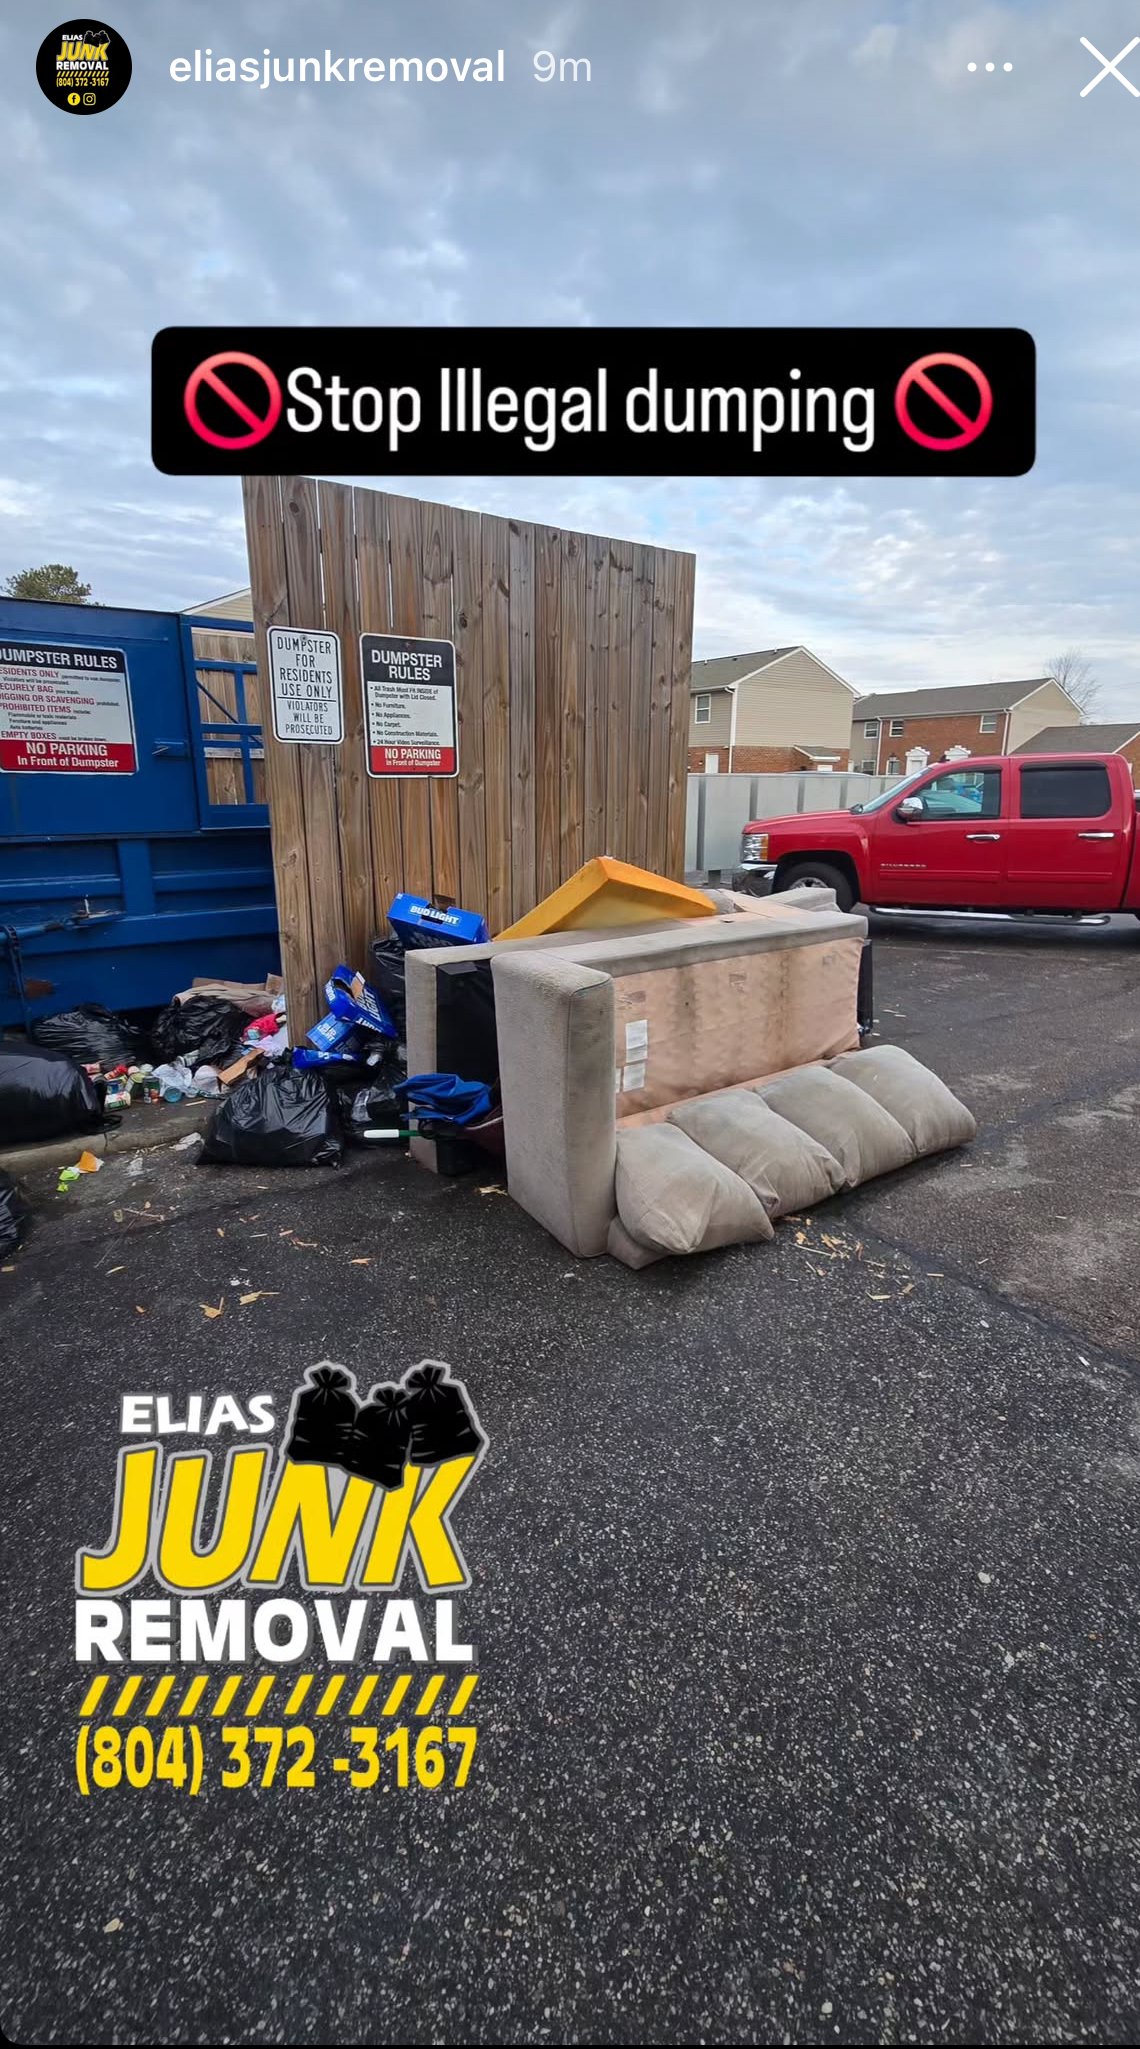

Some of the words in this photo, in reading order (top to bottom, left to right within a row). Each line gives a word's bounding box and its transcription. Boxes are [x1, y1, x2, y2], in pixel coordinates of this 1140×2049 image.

[277, 637, 332, 654] DUMPSTER
[0, 648, 71, 666] UMPSTER
[74, 653, 118, 669] RULES
[296, 654, 316, 668] FOR
[371, 649, 443, 668] DUMPSTER
[0, 667, 38, 677] ESIDENTS
[40, 670, 59, 678] ONLY
[280, 668, 333, 684] RESIDENTS
[389, 665, 431, 681] RULES
[0, 683, 36, 692] ECURELY
[37, 685, 54, 693] BAG
[281, 683, 302, 697] USE
[306, 684, 332, 699] ONLY
[0, 693, 30, 701] IGGING
[45, 695, 95, 705] SCAVENGING
[47, 705, 72, 713] ITEMS
[287, 700, 329, 712] VIOLATORS
[293, 713, 312, 723] WILL
[314, 714, 324, 724] BE
[1, 730, 29, 739] EMPTY
[31, 732, 57, 740] BOXES
[285, 724, 333, 736] PROSECUTED
[26, 742, 47, 755] NO
[50, 743, 108, 757] PARKING
[385, 748, 399, 759] NO
[400, 748, 441, 760] PARKING
[17, 756, 28, 766] In
[30, 756, 57, 767] Front
[60, 757, 70, 767] of
[72, 757, 119, 769] Dumpster
[409, 905, 430, 916] BUD
[430, 910, 460, 924] LIGHT
